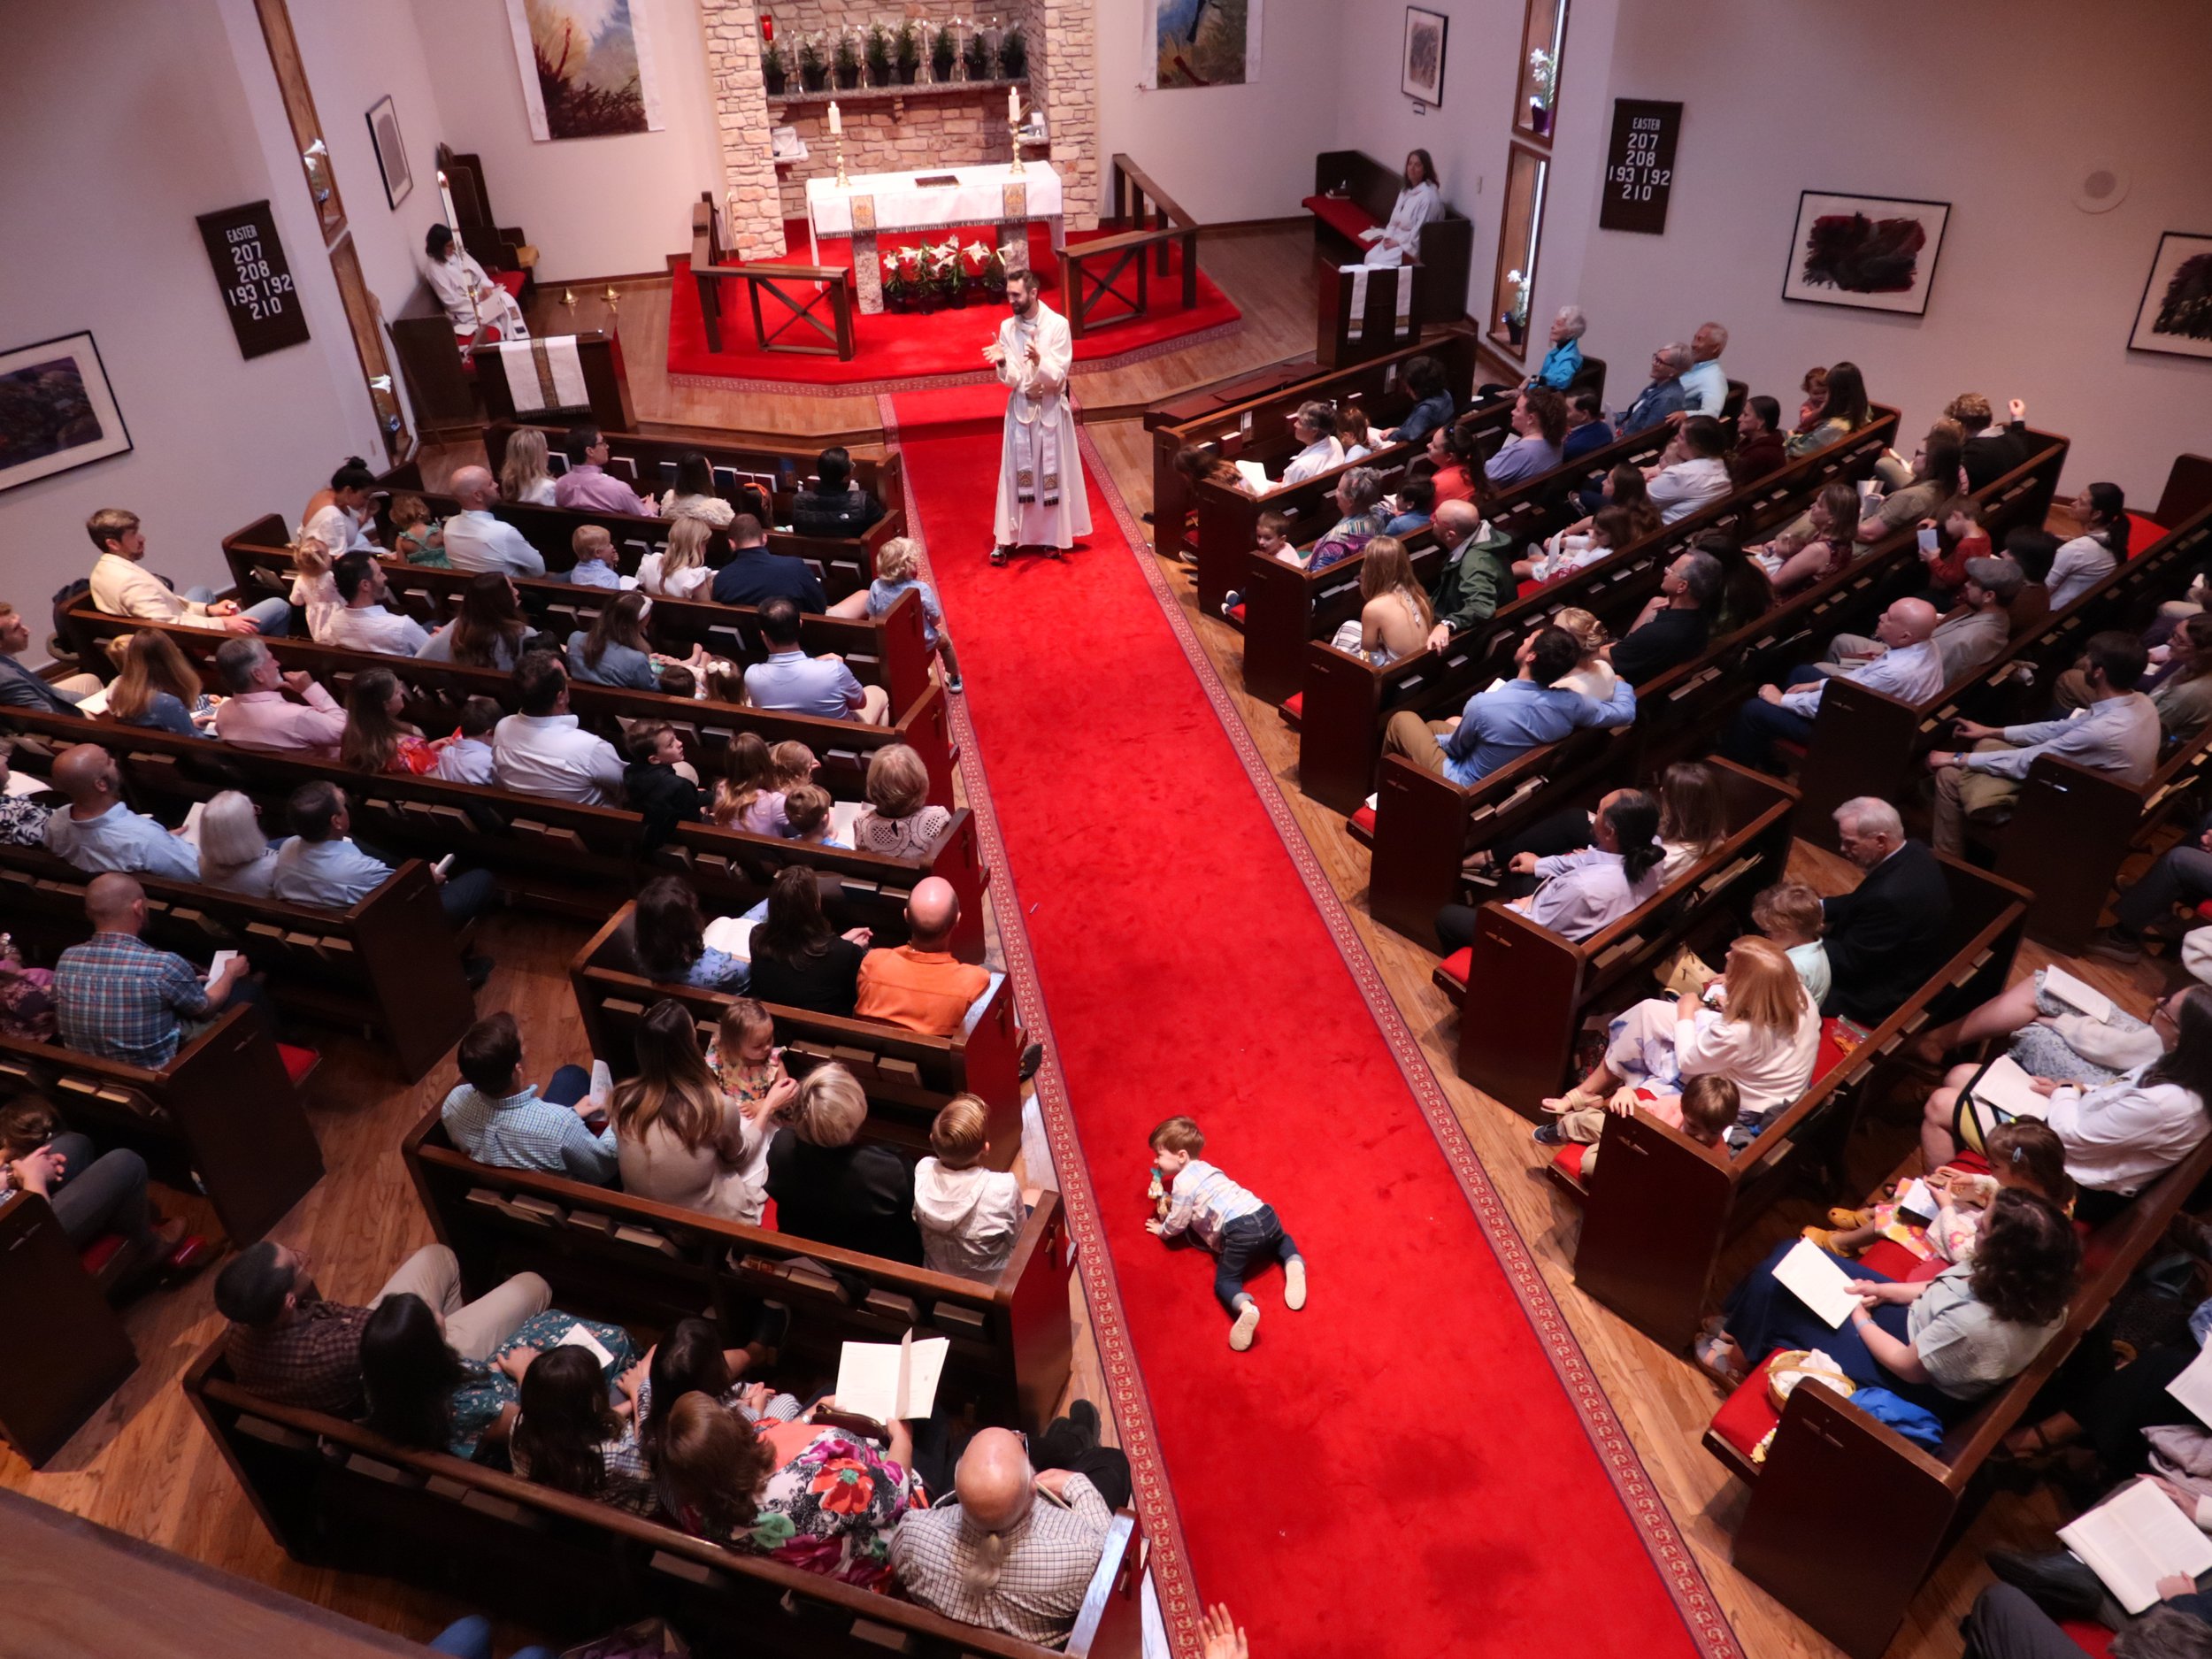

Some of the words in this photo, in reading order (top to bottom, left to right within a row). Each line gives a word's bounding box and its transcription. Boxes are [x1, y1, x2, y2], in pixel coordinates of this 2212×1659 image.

[1632, 118, 1661, 130] EASTER
[1628, 133, 1658, 150] 207
[1625, 150, 1655, 166] 208
[1609, 165, 1635, 182] 193
[1643, 168, 1671, 186] 192
[1622, 185, 1652, 201] 210
[226, 225, 257, 243] EASTER
[231, 241, 263, 265] 207
[237, 260, 270, 283] 208
[229, 284, 257, 306] 193
[263, 274, 293, 296] 192
[250, 297, 281, 320] 210
